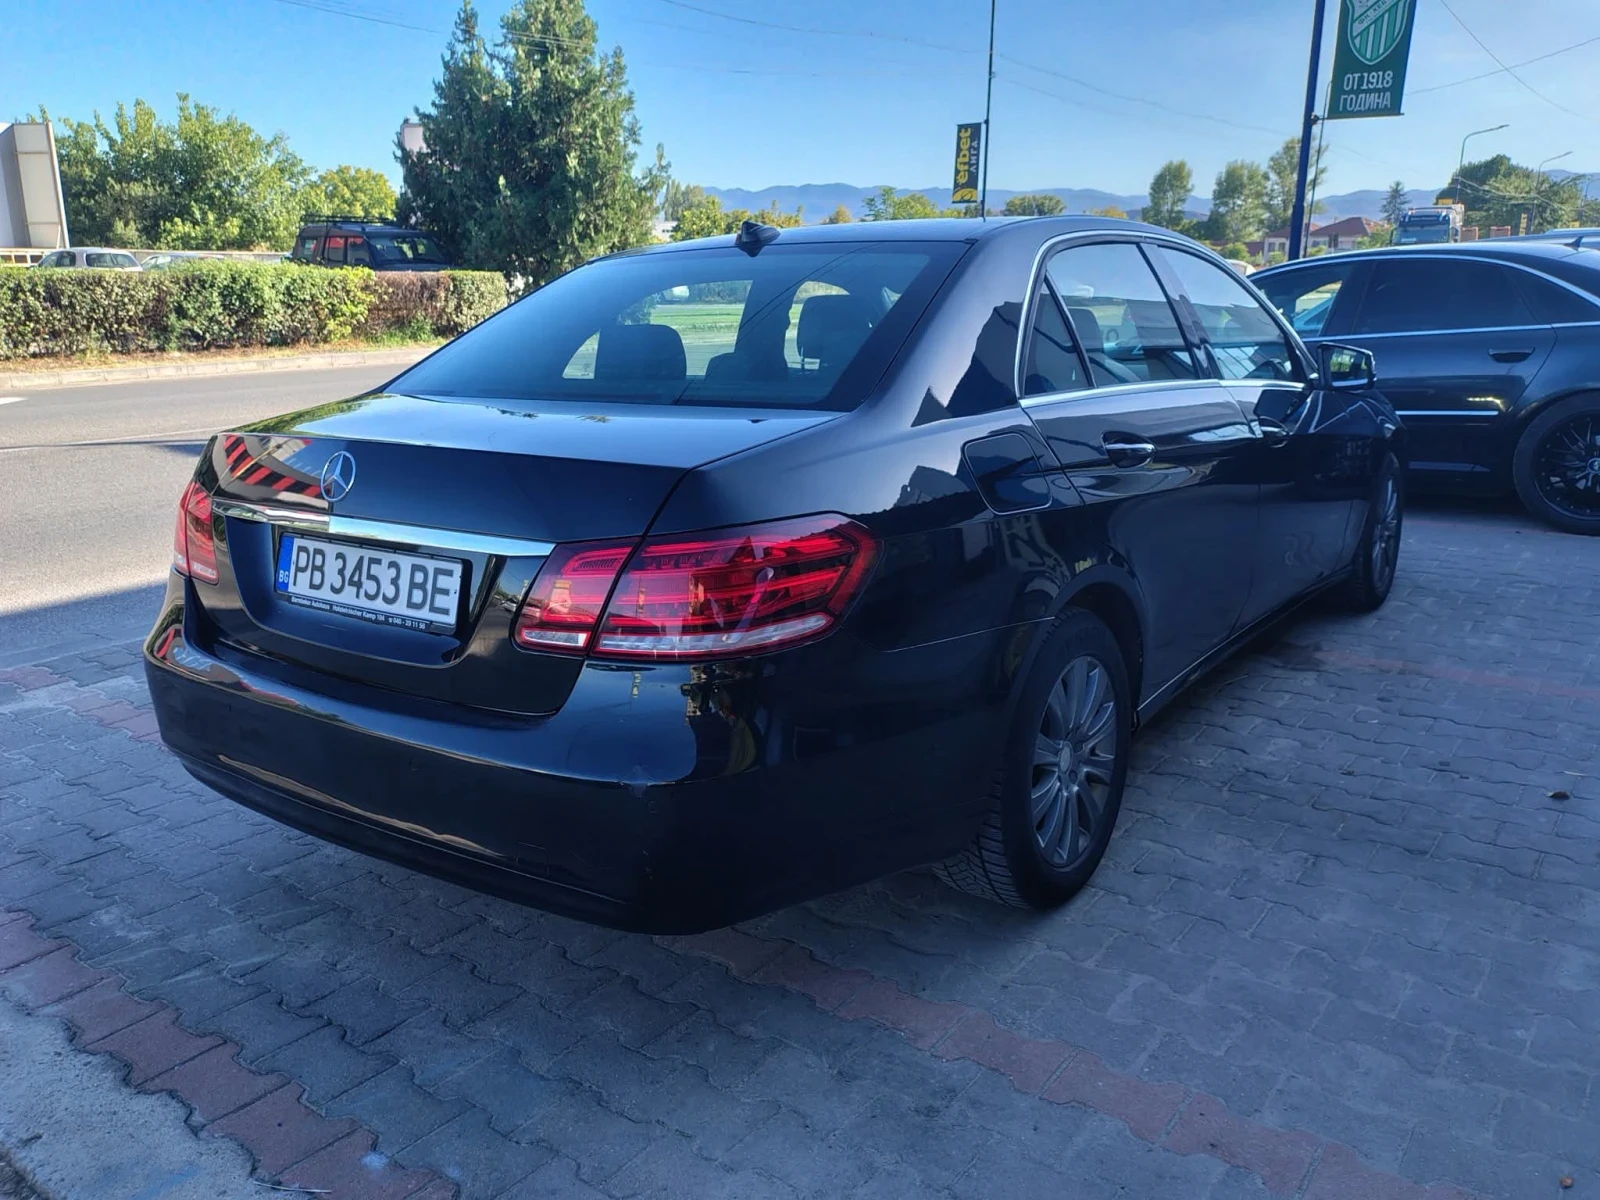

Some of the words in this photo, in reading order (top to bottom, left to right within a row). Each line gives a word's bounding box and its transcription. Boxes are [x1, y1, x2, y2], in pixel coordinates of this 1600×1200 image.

[1344, 73, 1361, 91] ОТ
[1361, 71, 1394, 89] 1918
[1339, 92, 1391, 112] ГОДИНА
[956, 127, 972, 185] efbet
[278, 571, 289, 583] BG
[293, 545, 326, 591] PB
[330, 552, 400, 605] 3453
[406, 563, 454, 616] BE
